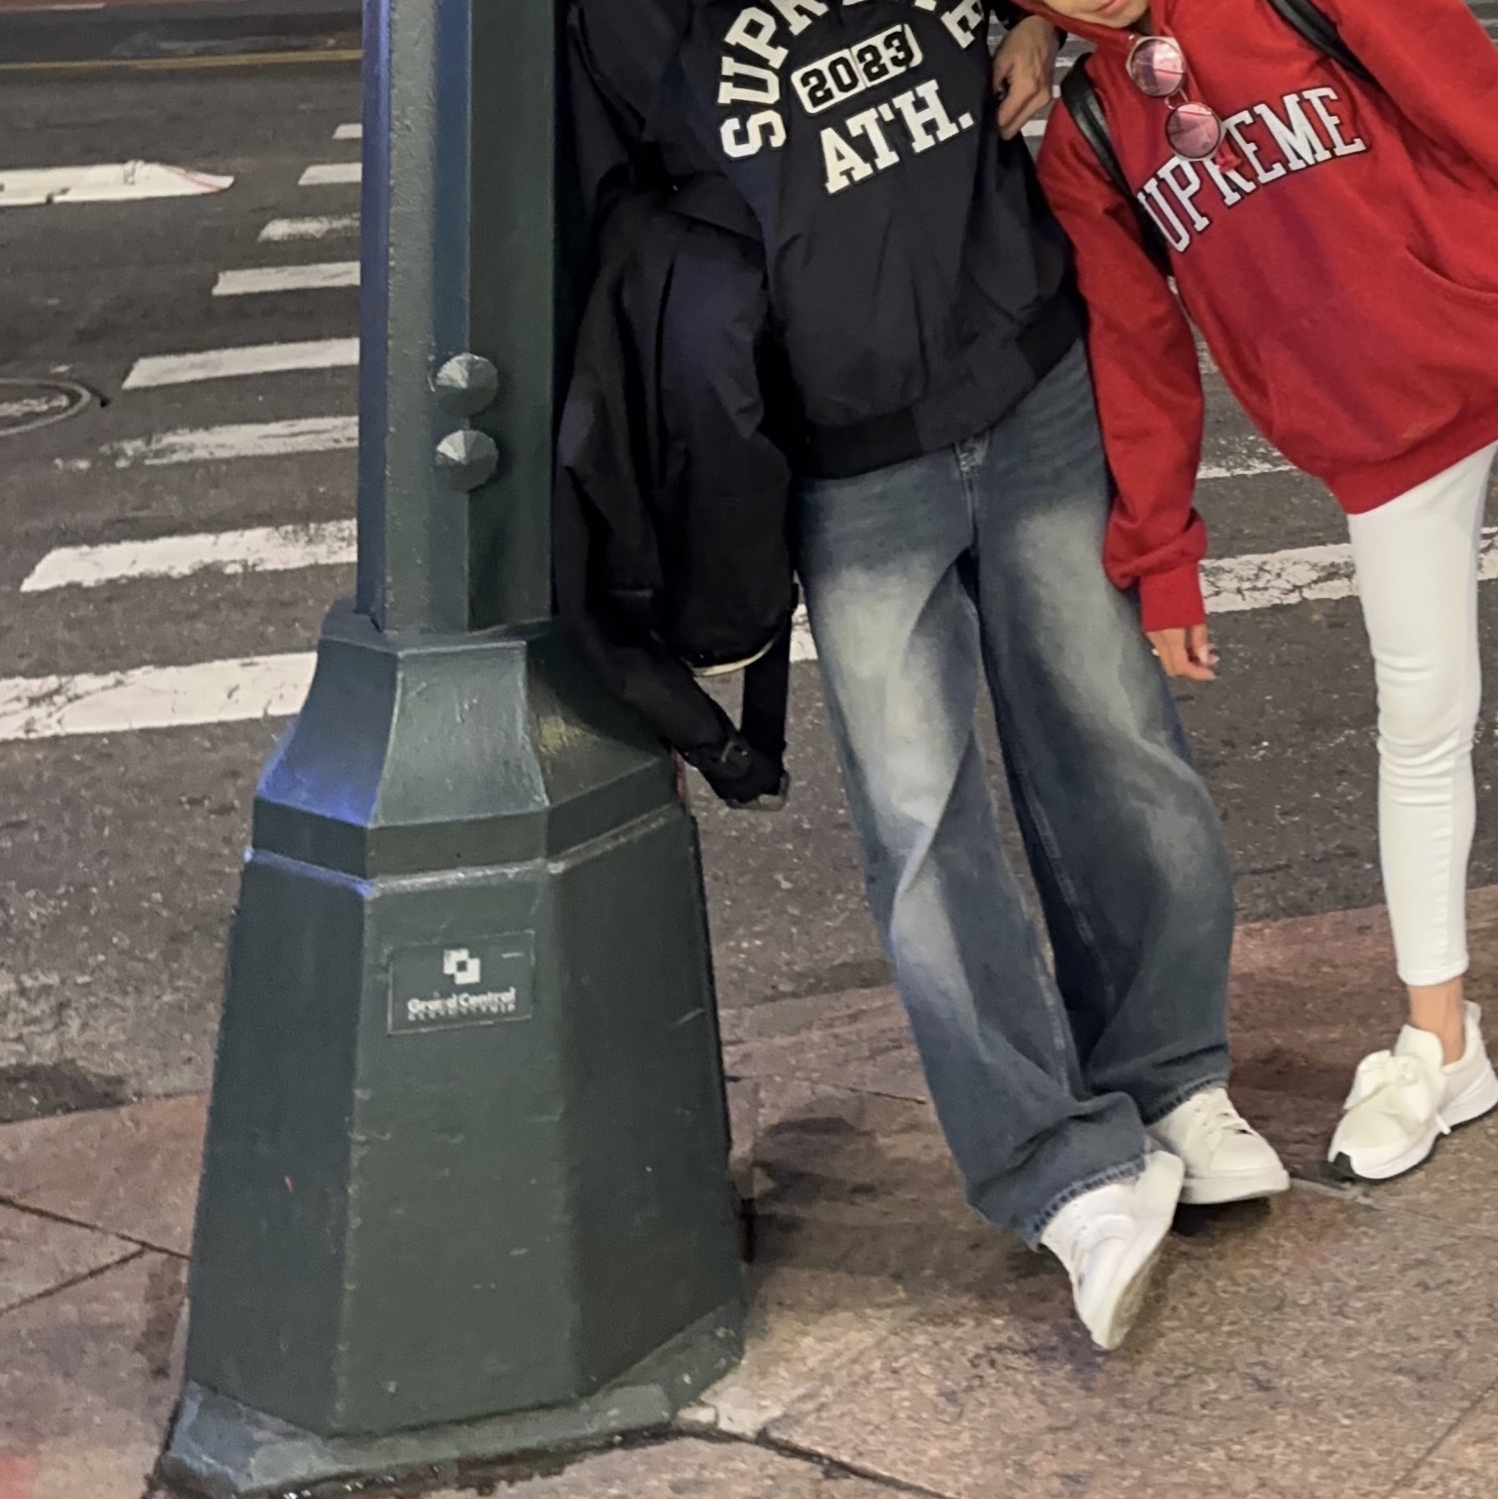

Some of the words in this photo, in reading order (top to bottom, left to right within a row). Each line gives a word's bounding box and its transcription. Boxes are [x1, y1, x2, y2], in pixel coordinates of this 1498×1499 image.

[800, 30, 916, 109] 2023
[820, 79, 975, 194] ATH.
[1136, 87, 1367, 252] UPREME
